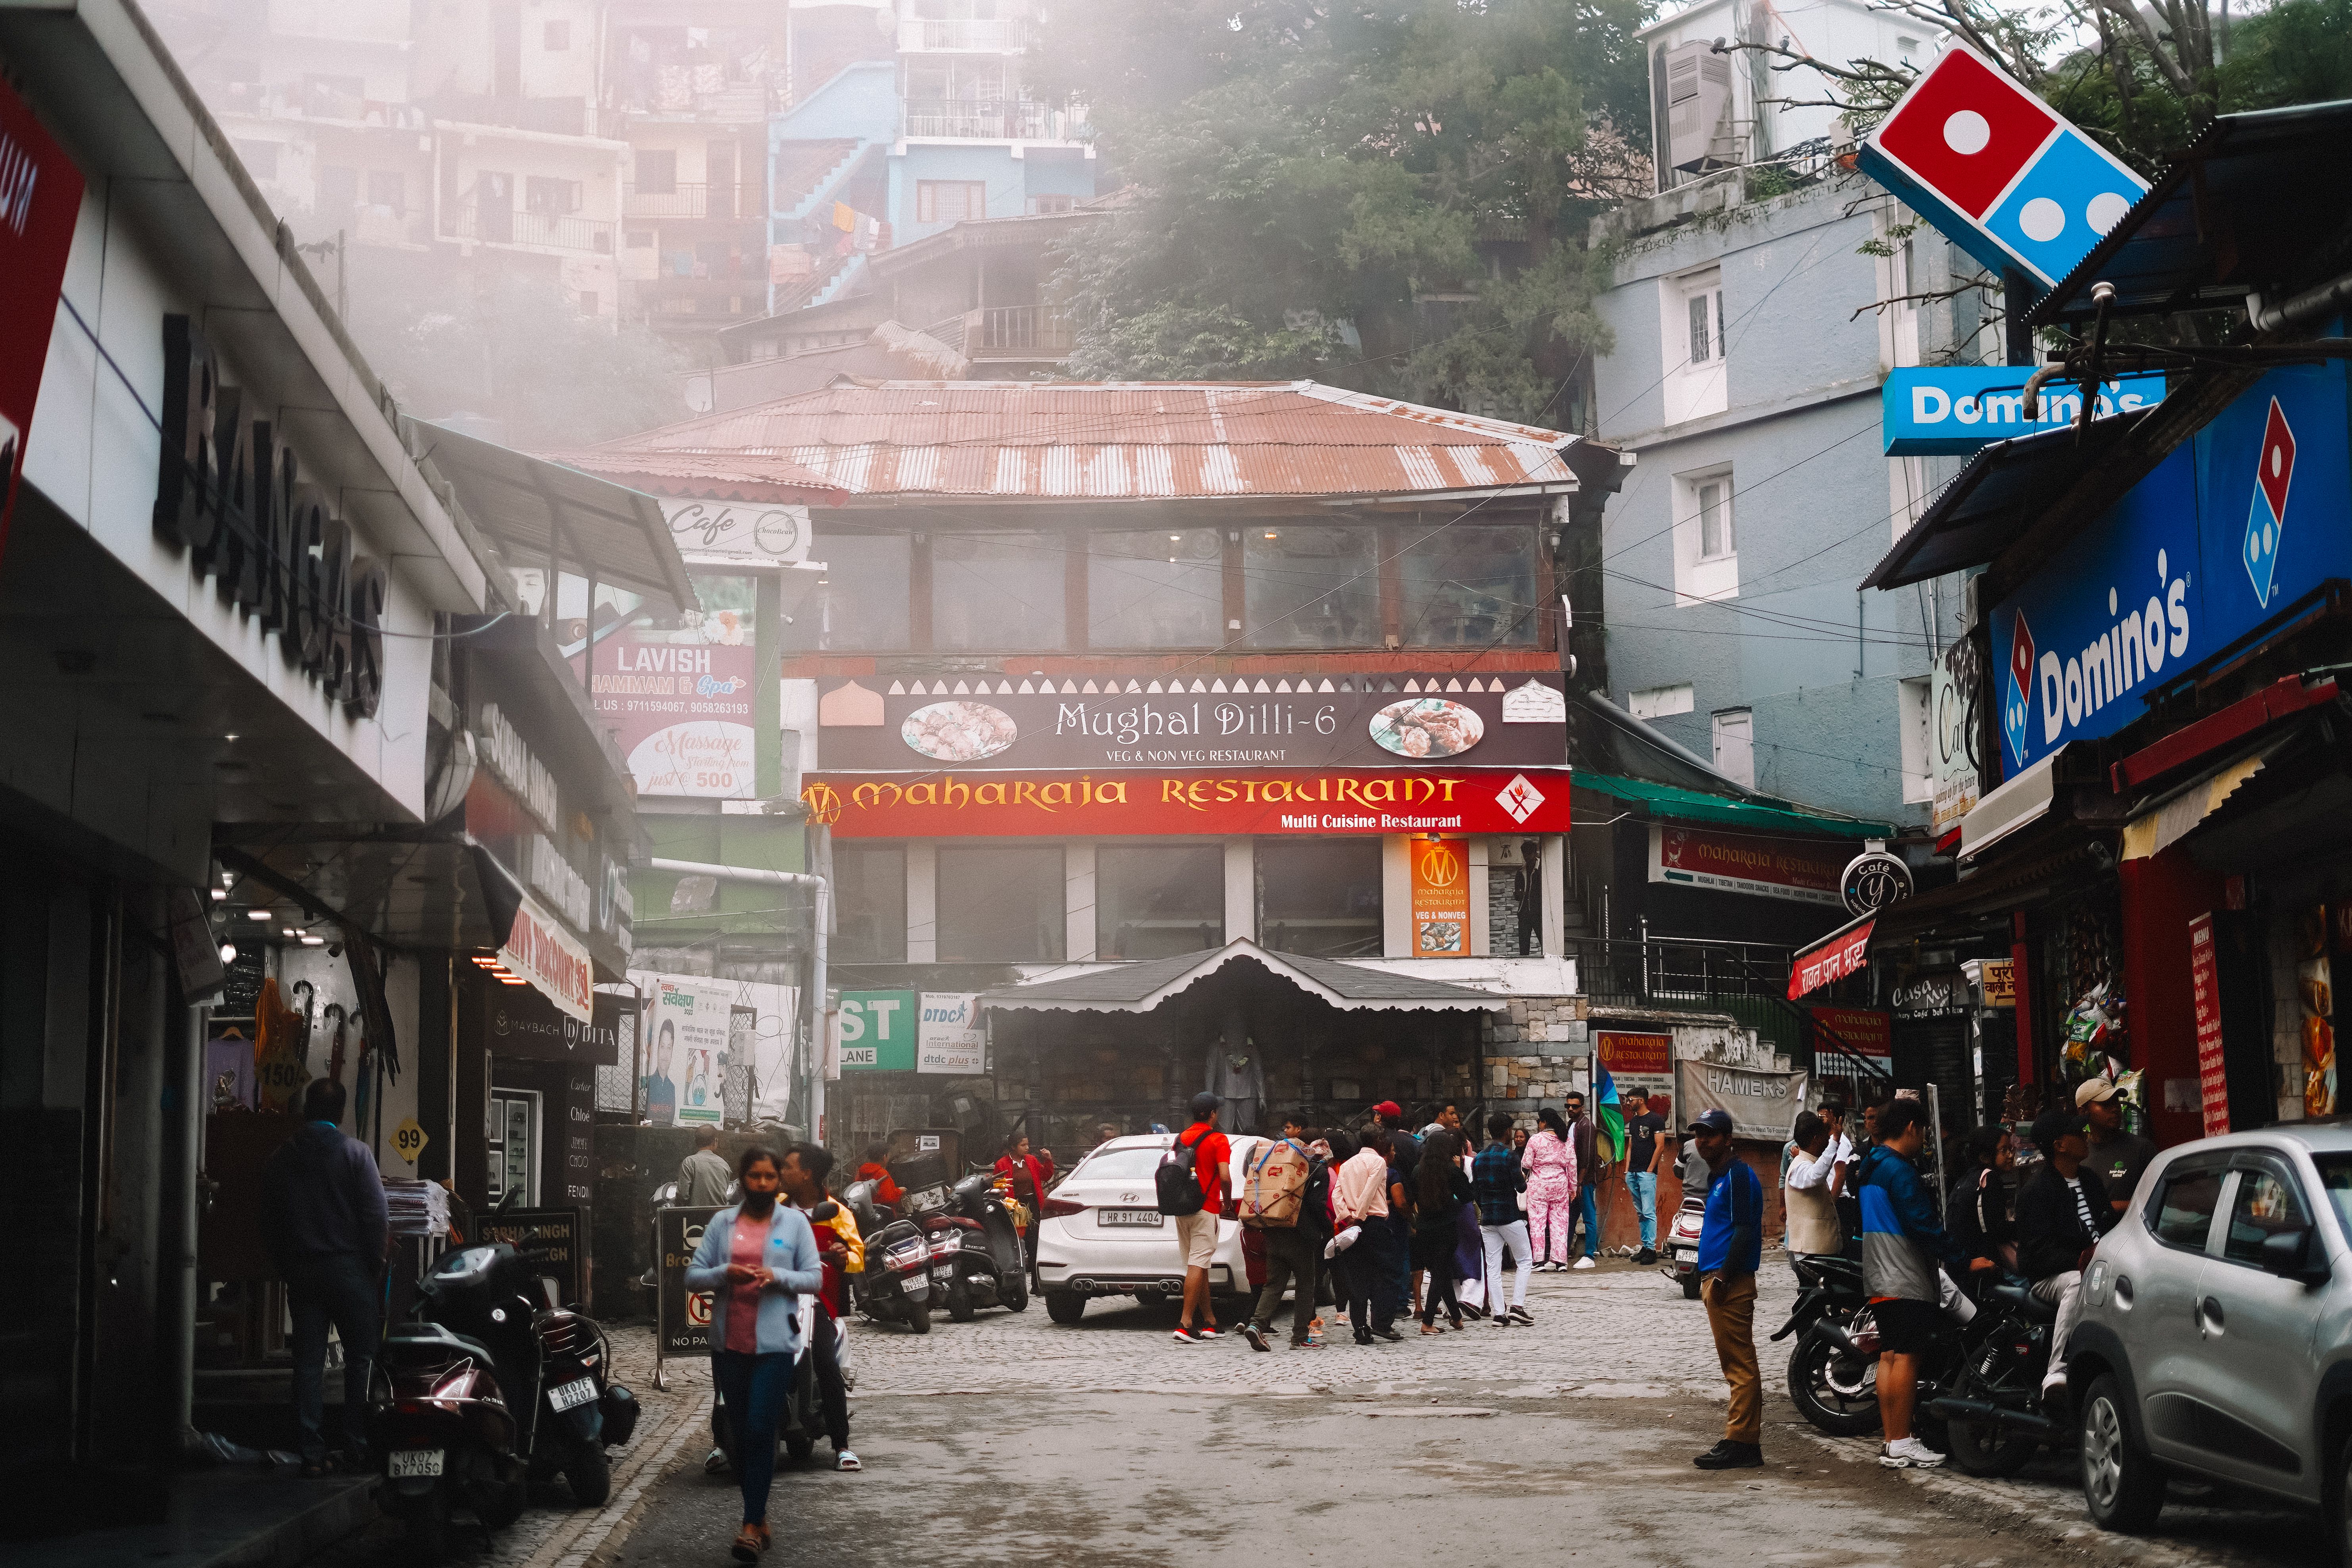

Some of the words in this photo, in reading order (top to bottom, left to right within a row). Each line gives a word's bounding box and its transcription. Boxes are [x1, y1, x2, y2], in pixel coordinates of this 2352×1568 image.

[669, 504, 737, 545] Cafe
[757, 527, 793, 535] ChocoBean
[2039, 548, 2190, 745] Domino's
[618, 647, 710, 674] LAVISH
[592, 675, 674, 695] HAMMAM
[697, 674, 735, 698] Spa
[603, 700, 618, 710] US
[691, 702, 749, 714] 9058263193
[1055, 702, 1198, 745] Mughal
[1214, 702, 1336, 735] Dilli-6
[1939, 683, 1965, 764] Caf
[655, 730, 742, 758] Massage
[686, 756, 725, 769] Starting
[726, 757, 749, 770] from
[1106, 750, 1131, 762] VEG
[1135, 750, 1144, 762] &
[1147, 750, 1177, 762] NON
[1180, 749, 1205, 761] VEG
[1210, 749, 1285, 761] RESTAURANT
[648, 772, 674, 789] just
[697, 772, 733, 787] 500
[1281, 814, 1317, 828] Multi
[1322, 814, 1377, 828] Cuisine
[1380, 813, 1462, 827] Restaurant
[1858, 862, 1890, 875] Café
[1697, 875, 1715, 885] MUGHLAI
[1718, 878, 1733, 887] TIBETAN
[1736, 881, 1755, 891] TANDOORI
[1755, 884, 1769, 893] SNACKS
[1793, 889, 1805, 898] NORTH
[1806, 891, 1818, 900] INDIAN
[1415, 912, 1429, 920] VEG
[1431, 912, 1437, 920] &
[1439, 911, 1466, 920] NONVEG
[2194, 926, 2209, 946] MENU
[1823, 953, 1841, 983] पान
[1892, 980, 1932, 1007] Casa
[1926, 983, 1950, 1009] Mia
[924, 1008, 957, 1023] DTDC
[511, 1020, 559, 1035] MAYBACH
[583, 1025, 615, 1046] DITA
[926, 1040, 979, 1048] International
[924, 1054, 946, 1064] dtdc
[948, 1056, 970, 1066] plus
[571, 1077, 591, 1092] Cartier
[1707, 1069, 1788, 1099] HAMERS
[570, 1106, 590, 1123] Chloé
[398, 1129, 420, 1148] 99
[571, 1137, 588, 1150] JIMMY
[569, 1155, 588, 1168] CHOO
[568, 1185, 588, 1198] FENDI
[1107, 1213, 1118, 1222] HR
[1122, 1213, 1131, 1222] 91
[1137, 1213, 1159, 1222] 4404
[907, 1276, 922, 1284] UK07
[672, 1337, 689, 1346] NO
[557, 1378, 588, 1397] UK07F
[561, 1388, 591, 1407] H2207
[403, 1452, 432, 1463] UK07
